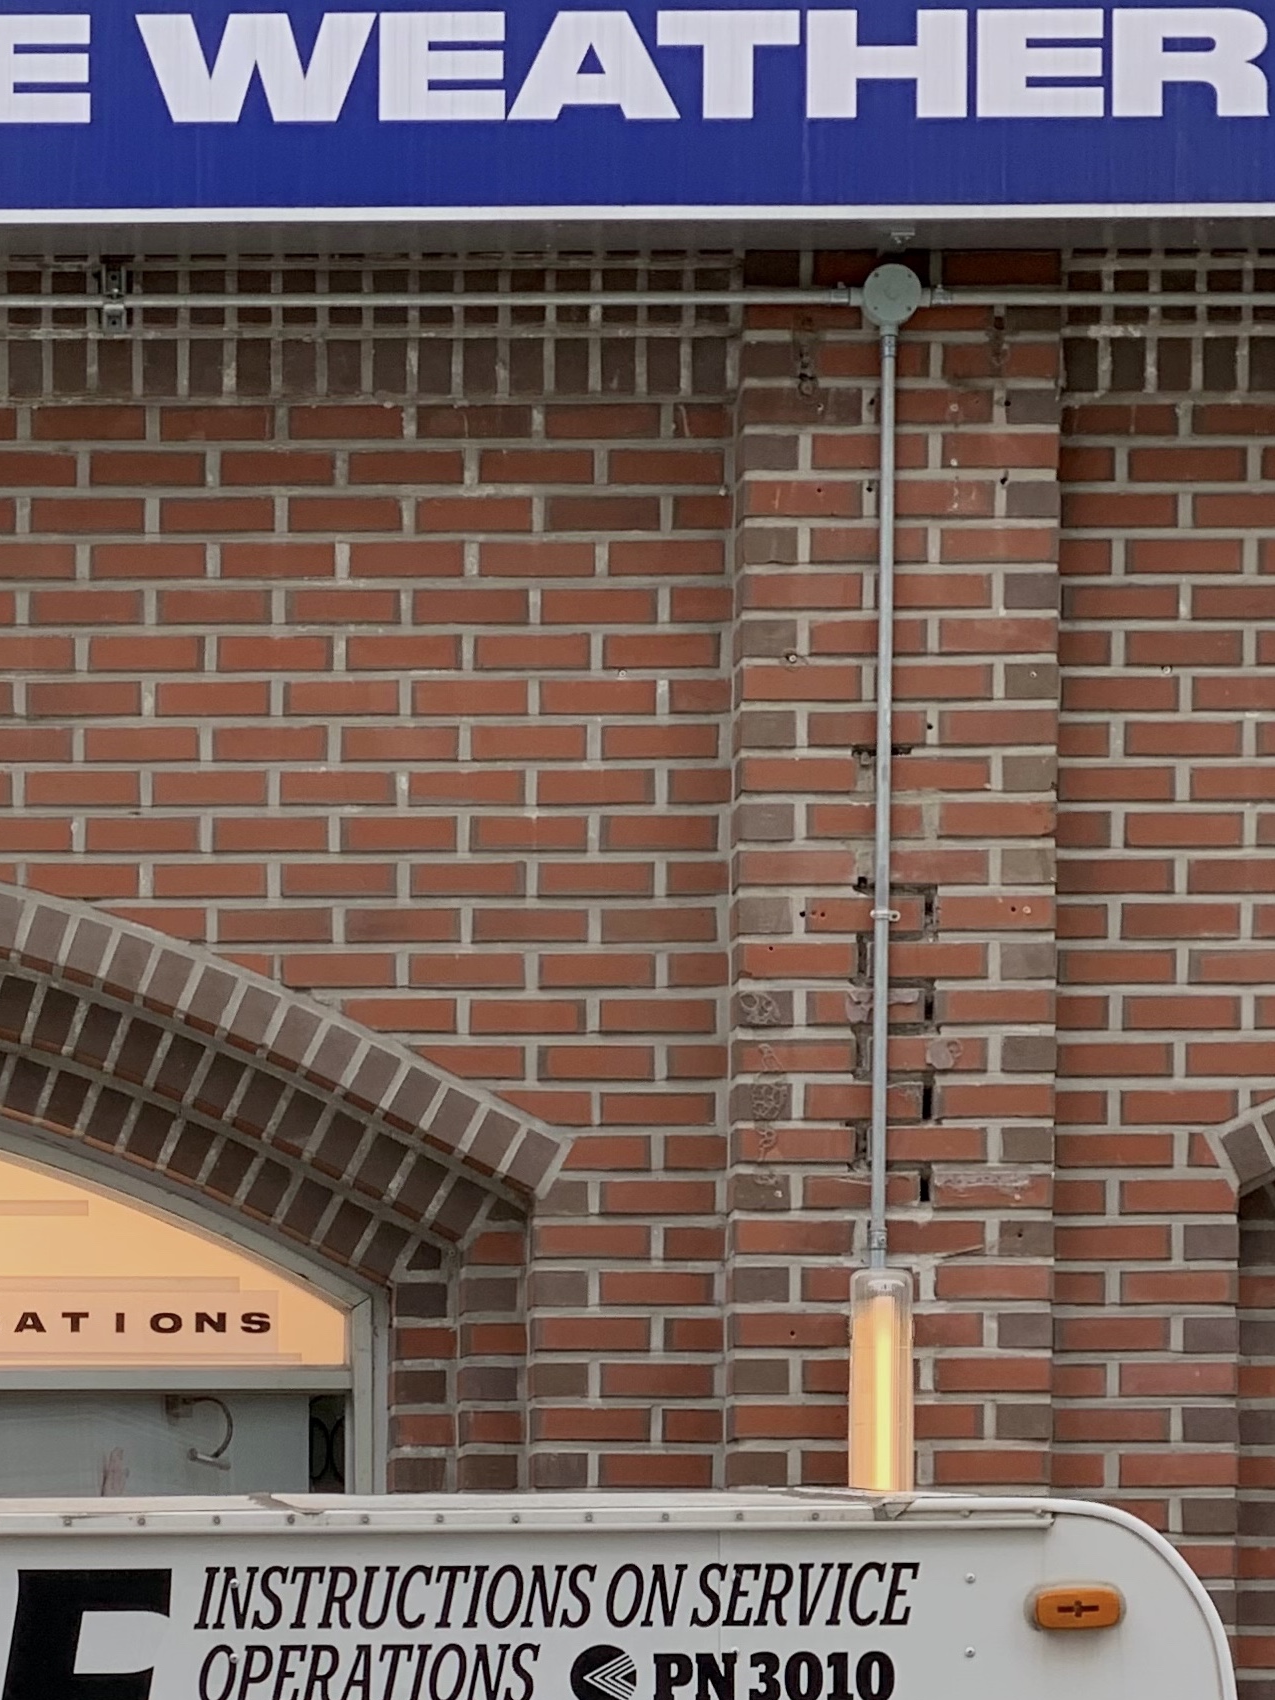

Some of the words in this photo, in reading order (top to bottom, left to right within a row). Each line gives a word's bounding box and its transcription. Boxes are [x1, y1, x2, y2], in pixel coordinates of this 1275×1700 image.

[135, 8, 1270, 123] WEATHER
[193, 1564, 597, 1630] INSTRUCTIONS
[606, 1563, 688, 1628] ON
[689, 1562, 921, 1628] SERVICE
